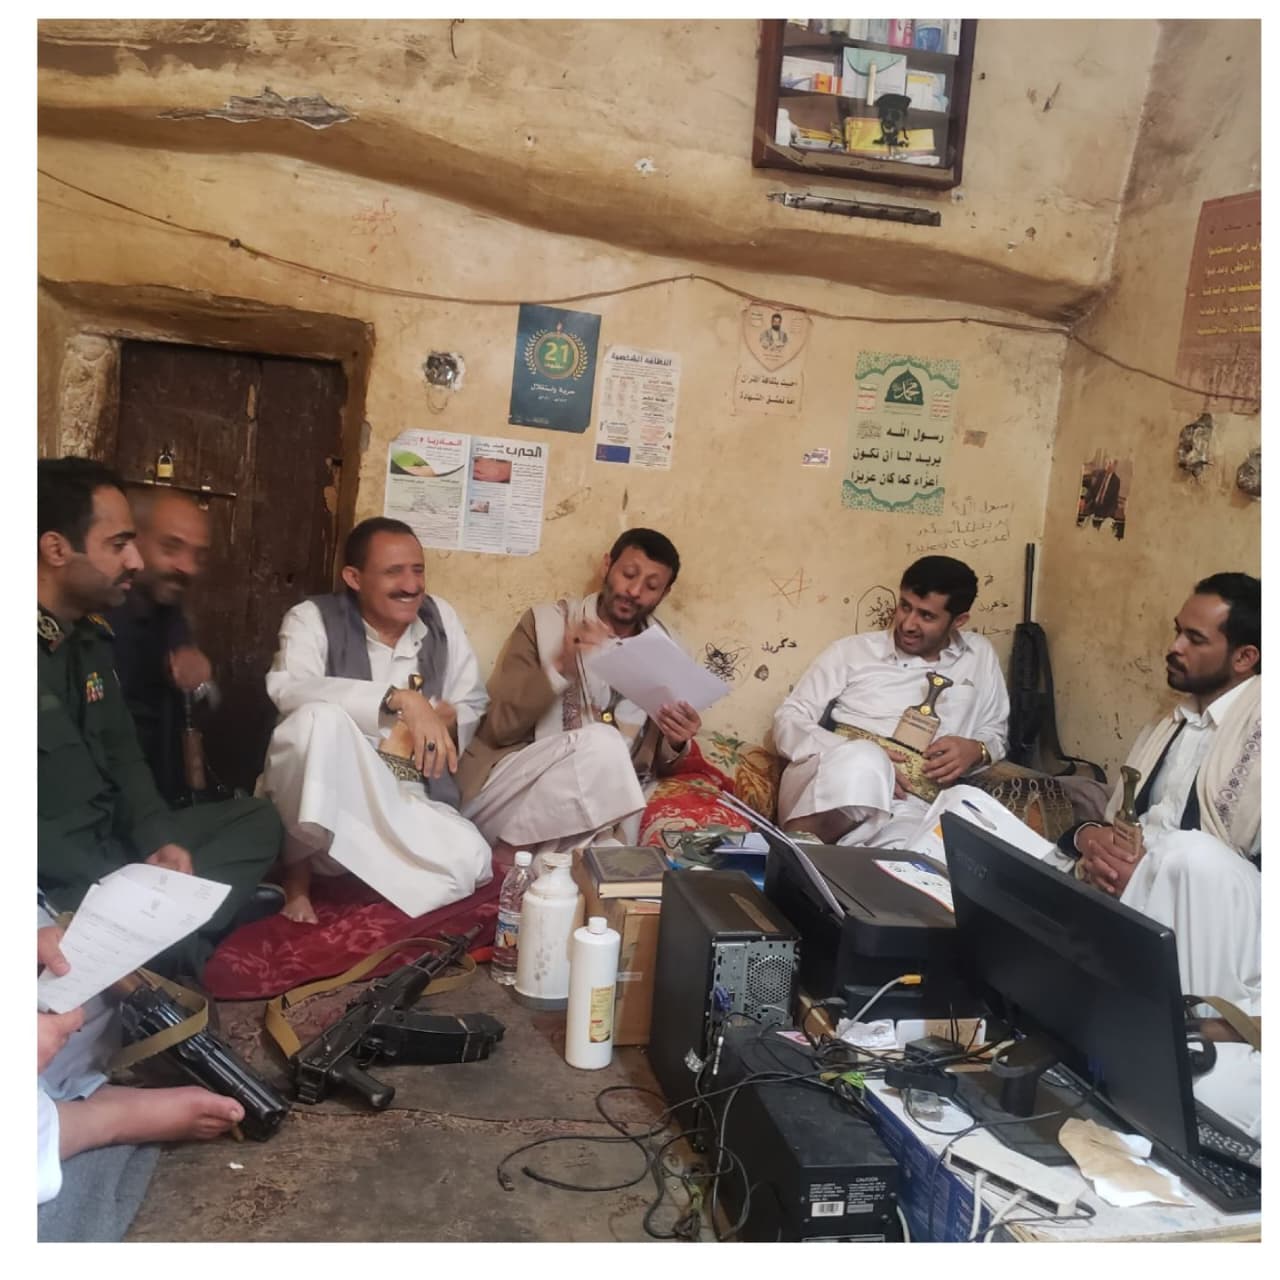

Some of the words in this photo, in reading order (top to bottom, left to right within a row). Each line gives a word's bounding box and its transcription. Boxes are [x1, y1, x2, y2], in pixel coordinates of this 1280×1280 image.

[544, 342, 569, 363] 21
[913, 428, 945, 444] رسول
[897, 450, 912, 461] لنا
[915, 453, 942, 468] يريد
